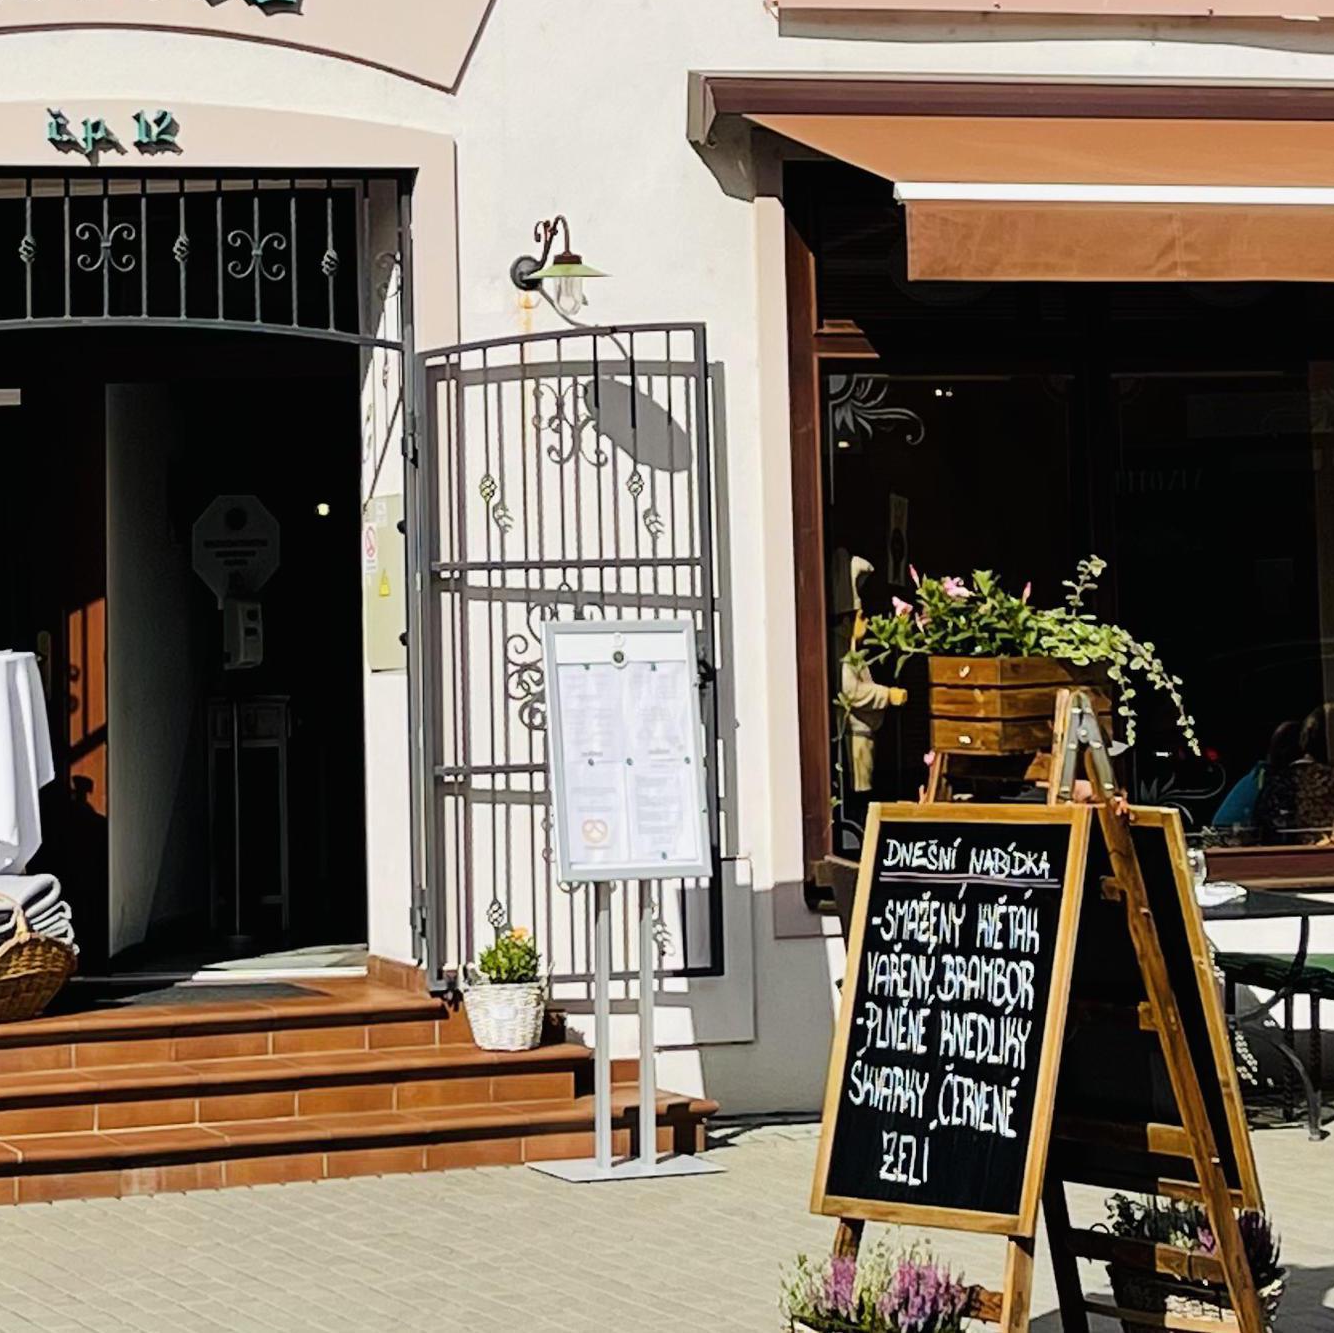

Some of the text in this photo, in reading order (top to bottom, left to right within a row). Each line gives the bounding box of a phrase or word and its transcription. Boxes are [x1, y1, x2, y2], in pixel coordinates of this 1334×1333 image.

[136, 109, 179, 145] 12
[883, 837, 1051, 879] DNEŠNÍ NABÍDKA
[976, 888, 1040, 955] KVĚTÁK
[936, 953, 1035, 1011] BRAMBOR
